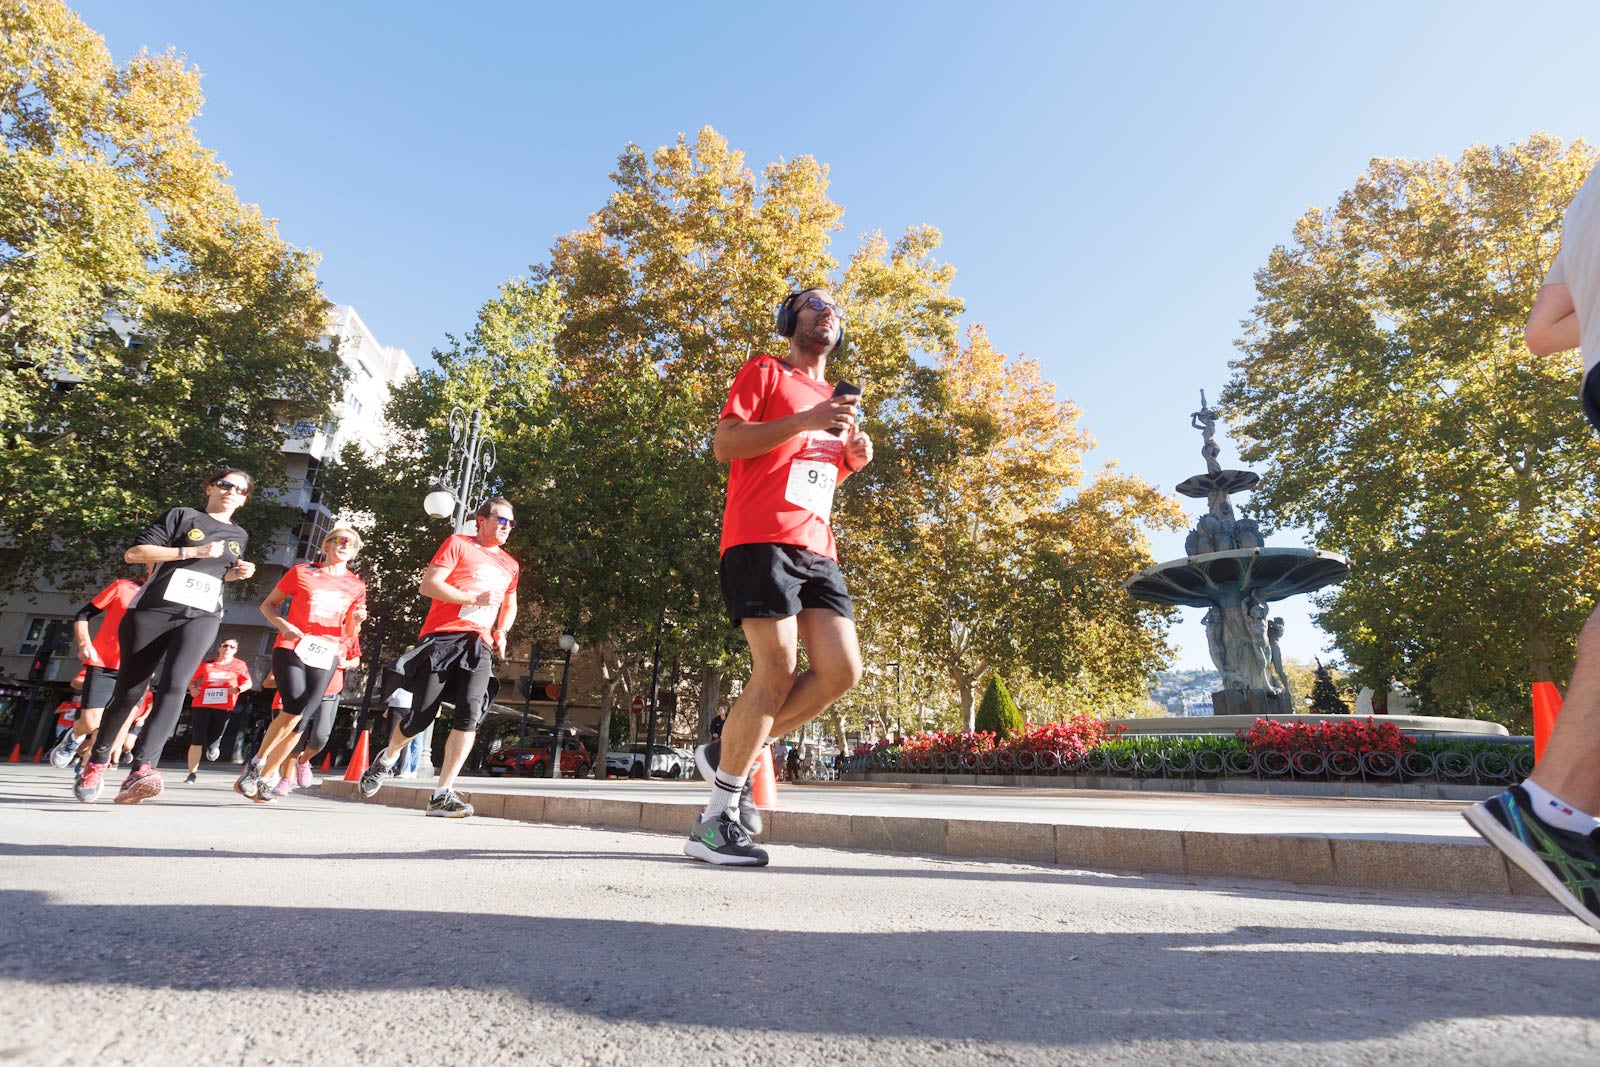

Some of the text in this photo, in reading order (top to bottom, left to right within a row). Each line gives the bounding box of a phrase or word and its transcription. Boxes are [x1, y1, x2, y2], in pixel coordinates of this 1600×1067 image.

[807, 469, 835, 494] 937
[185, 578, 211, 593] 599
[307, 642, 328, 655] 557
